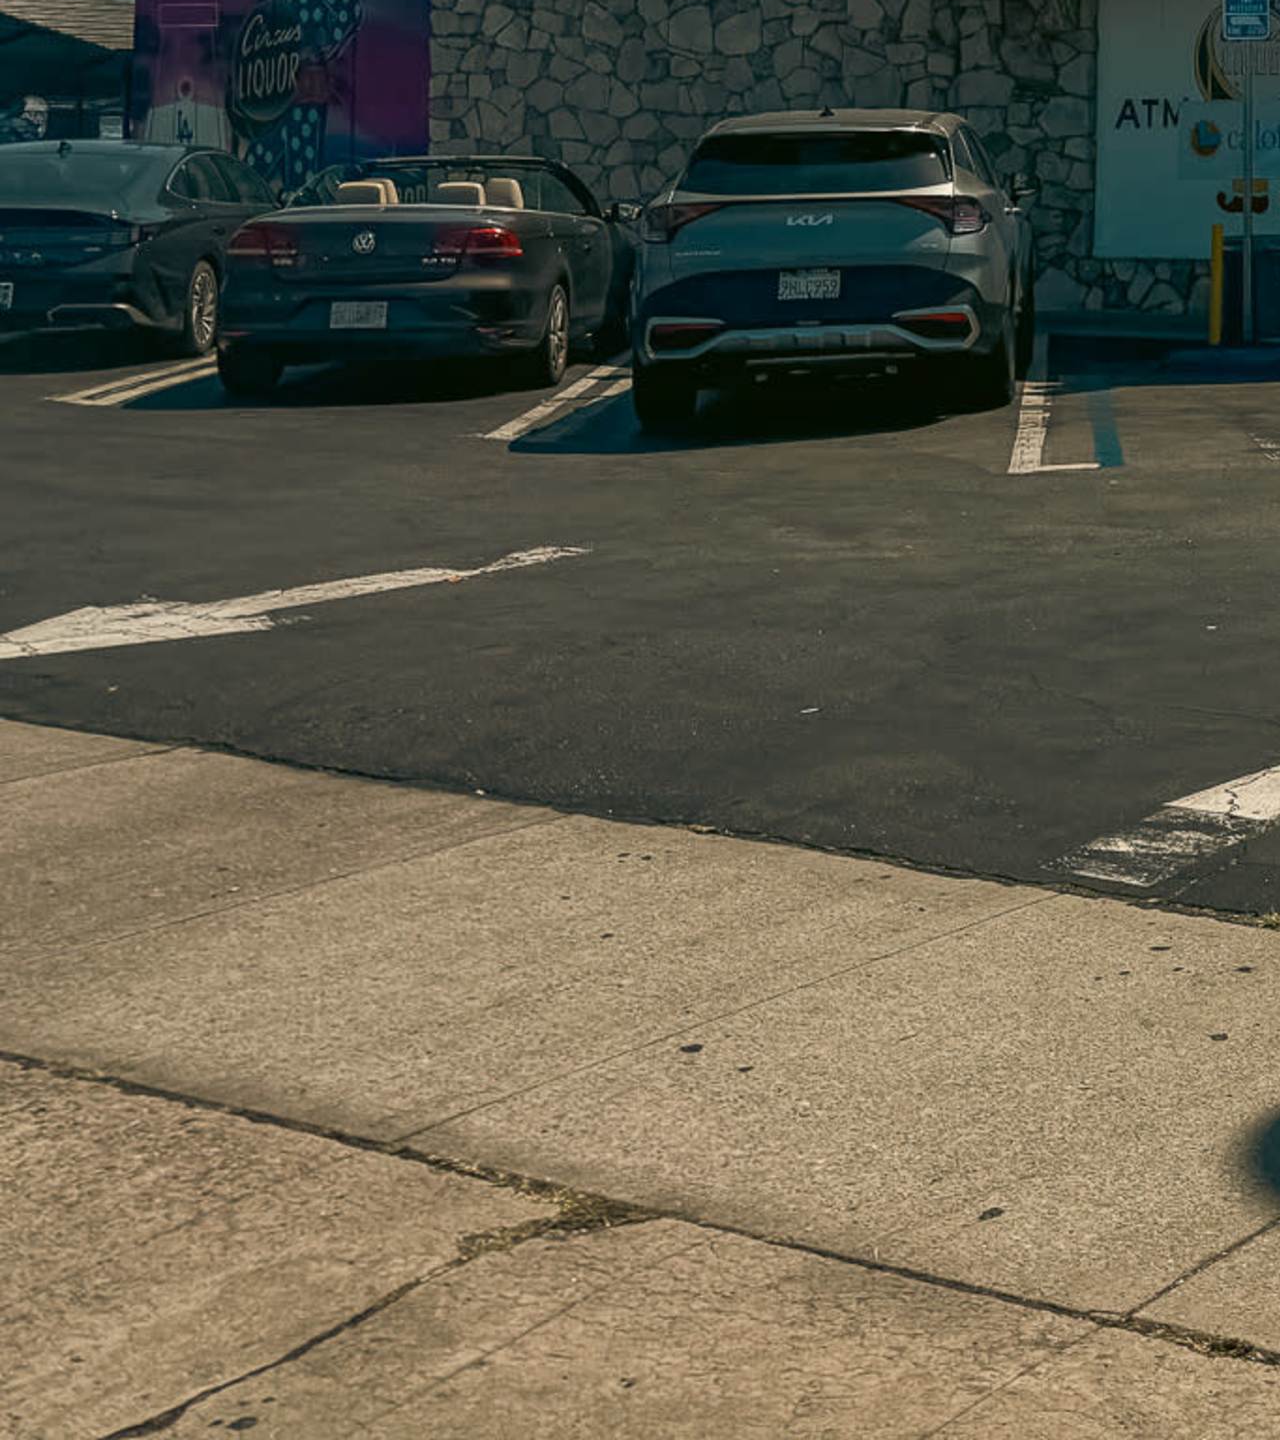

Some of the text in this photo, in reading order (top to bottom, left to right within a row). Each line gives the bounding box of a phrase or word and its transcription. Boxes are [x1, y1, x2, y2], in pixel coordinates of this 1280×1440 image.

[241, 14, 301, 57] Circus
[238, 50, 300, 101] LIQUOR
[786, 213, 833, 226] KIA
